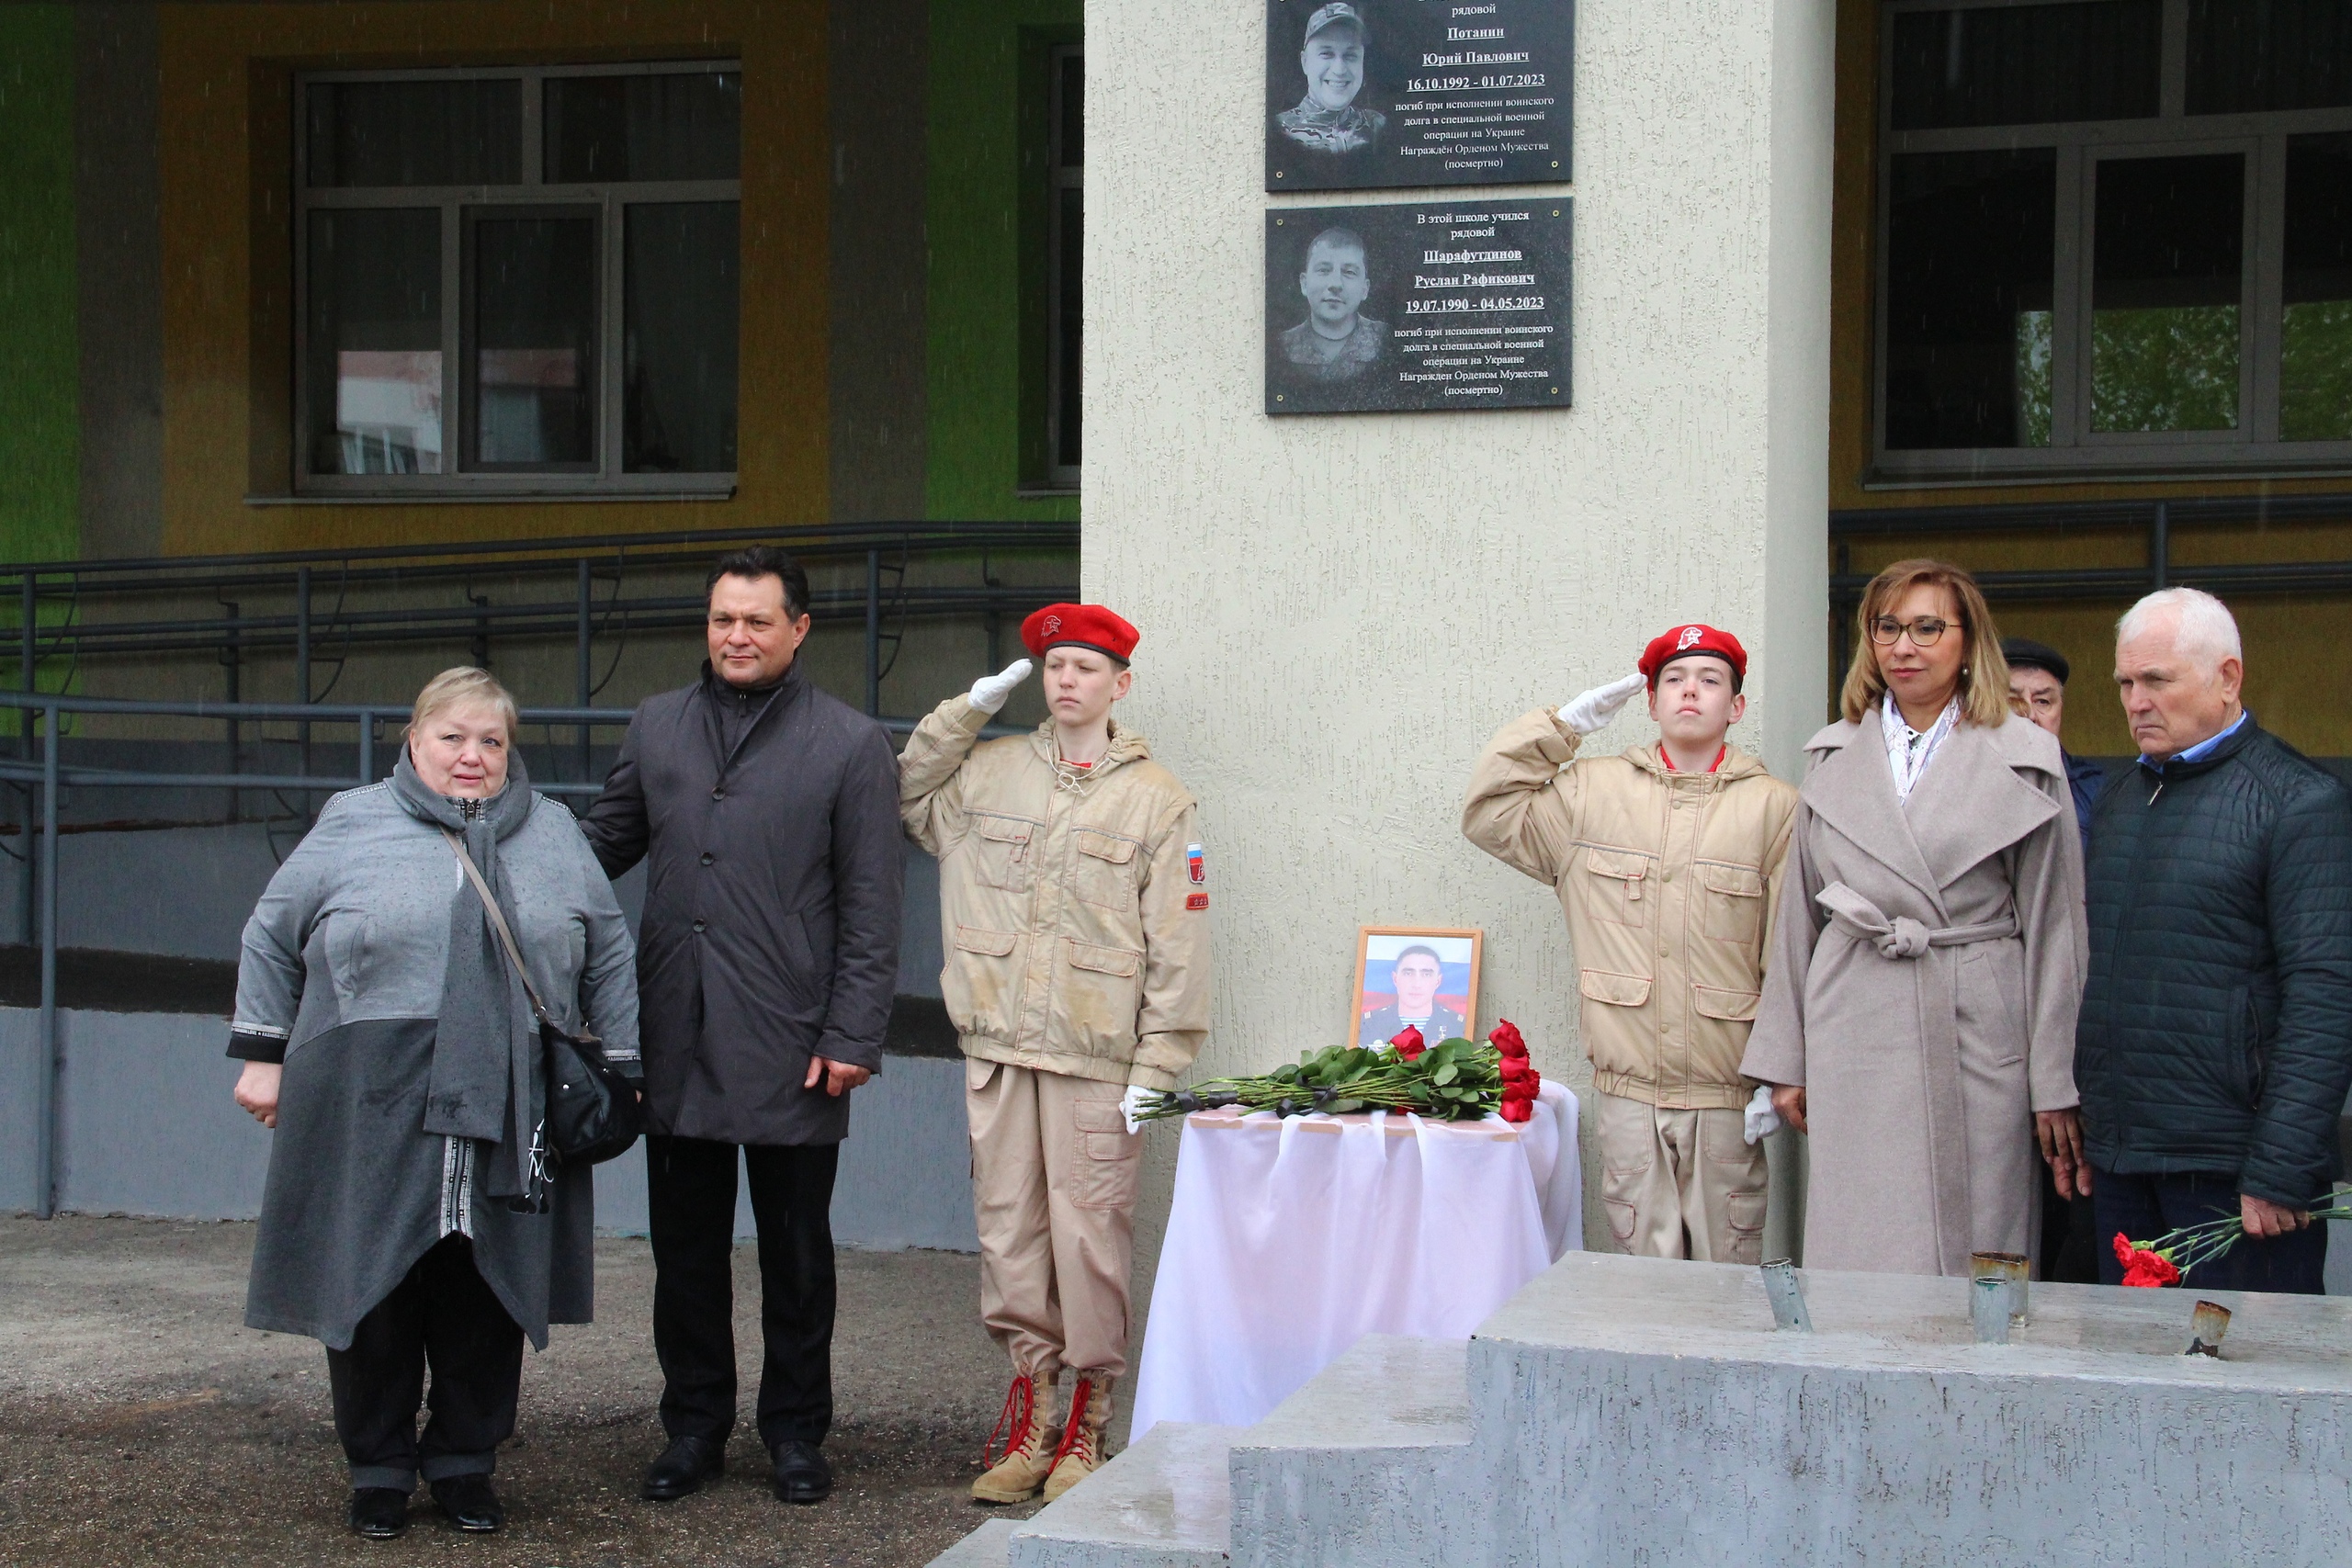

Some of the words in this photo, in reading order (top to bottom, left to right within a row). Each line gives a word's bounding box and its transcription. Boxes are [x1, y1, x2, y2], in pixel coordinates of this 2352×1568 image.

[1452, 4, 1496, 17] рядовой
[1447, 27, 1504, 40] Потанин
[1423, 52, 1462, 66] Юрий
[1465, 51, 1529, 63] Павлович
[1407, 77, 1470, 91] 16.10.1992
[1481, 73, 1545, 87] 01.07.2023
[1396, 100, 1423, 111] погиб
[1425, 102, 1443, 113] при
[1446, 98, 1503, 109] исполнении
[1506, 96, 1555, 107] воинского
[1404, 117, 1430, 127] долга
[1441, 113, 1502, 125] специальной
[1505, 111, 1544, 122] военной
[1423, 130, 1468, 141] операции
[1485, 128, 1525, 138] Украине
[1400, 144, 1453, 157] Награждён
[1454, 143, 1498, 155] Орденом
[1500, 141, 1549, 153] Мужества
[1444, 158, 1503, 171] (посмертно)
[1418, 214, 1425, 223] В
[1428, 213, 1453, 223] этой
[1455, 214, 1488, 222] школе
[1491, 212, 1530, 224] учился
[1451, 227, 1495, 240] рядовой
[1423, 249, 1522, 264] Шарафутдинов
[1415, 275, 1459, 288] Руслан
[1463, 273, 1535, 287] Рафикович
[1406, 299, 1469, 312] 19.07.1990
[1480, 297, 1544, 310] 04.05.2023
[1395, 327, 1422, 338] погиб
[1424, 329, 1442, 339] при
[1445, 325, 1502, 335] исполнении
[1505, 324, 1554, 333] воинского
[1403, 344, 1430, 353] долга
[1441, 340, 1501, 352] специальной
[1504, 338, 1544, 349] военной
[1422, 357, 1468, 367] операции
[1485, 355, 1524, 366] Украине
[1399, 372, 1452, 384] Награжден
[1454, 371, 1498, 382] Орденом
[1500, 369, 1549, 381] Мужества
[1444, 384, 1503, 396] (посмертно)
